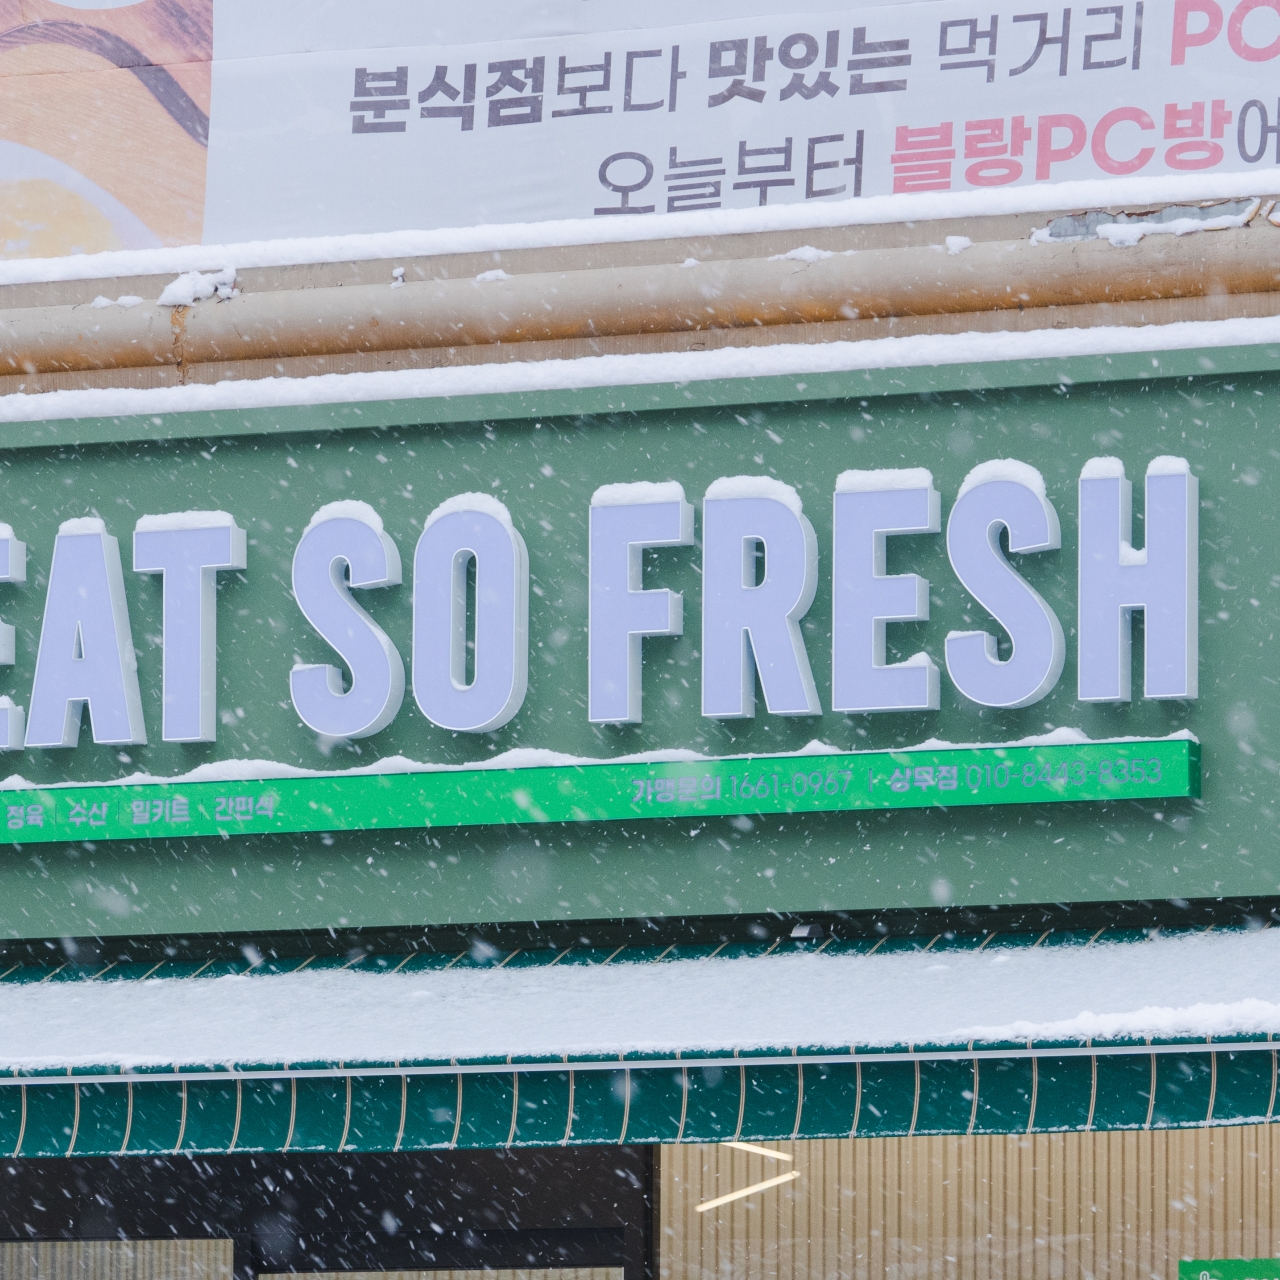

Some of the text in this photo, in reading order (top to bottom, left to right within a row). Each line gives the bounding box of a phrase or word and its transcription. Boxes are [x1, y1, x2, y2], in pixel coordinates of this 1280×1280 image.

[350, 45, 686, 134] 분식점보다
[707, 26, 913, 104] 맛있는
[938, 3, 1143, 83] 먹거리
[593, 129, 863, 215] 오늘부터
[290, 502, 530, 740] SO
[588, 458, 1199, 724] FRESH
[6, 805, 44, 829] 정육
[69, 802, 108, 827] 수산
[131, 798, 190, 824] 밀키트
[215, 795, 275, 821] 간편식
[632, 758, 1162, 805] 가맹문의 1661-0967 상무점 010-8443-8353
